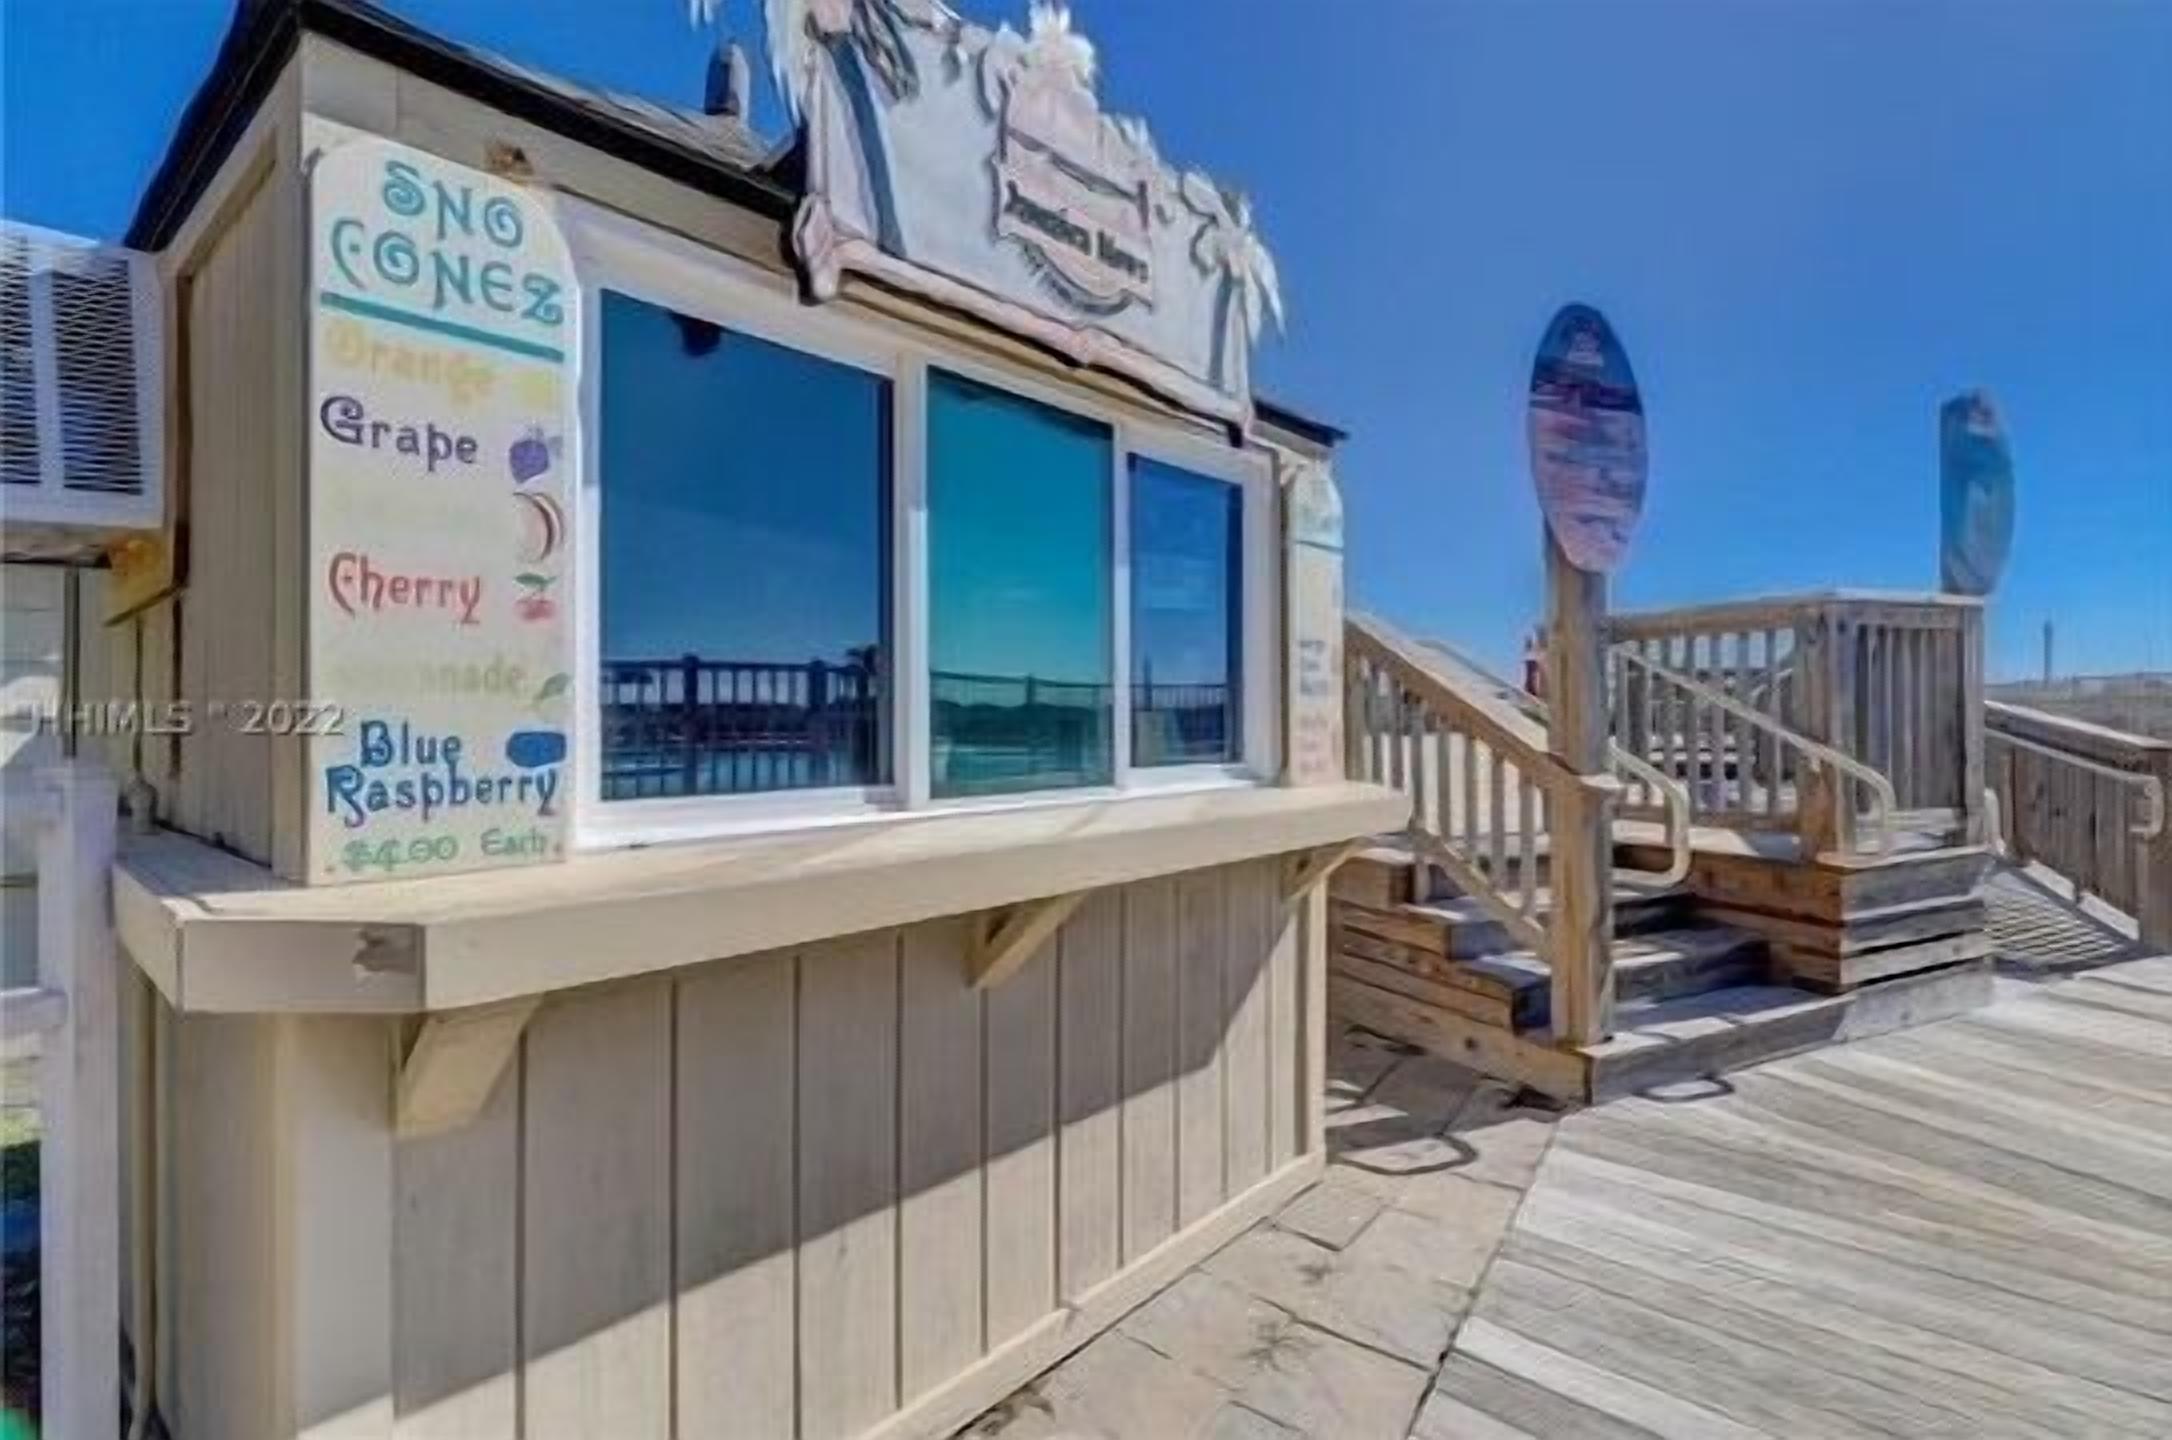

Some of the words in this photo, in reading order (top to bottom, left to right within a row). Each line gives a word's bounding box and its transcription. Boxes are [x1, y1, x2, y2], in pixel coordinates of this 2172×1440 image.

[383, 160, 523, 248] SNO
[320, 395, 479, 473] Grape
[329, 551, 480, 625] Cherry
[360, 719, 463, 769] Blue
[326, 763, 557, 829] Raspberry
